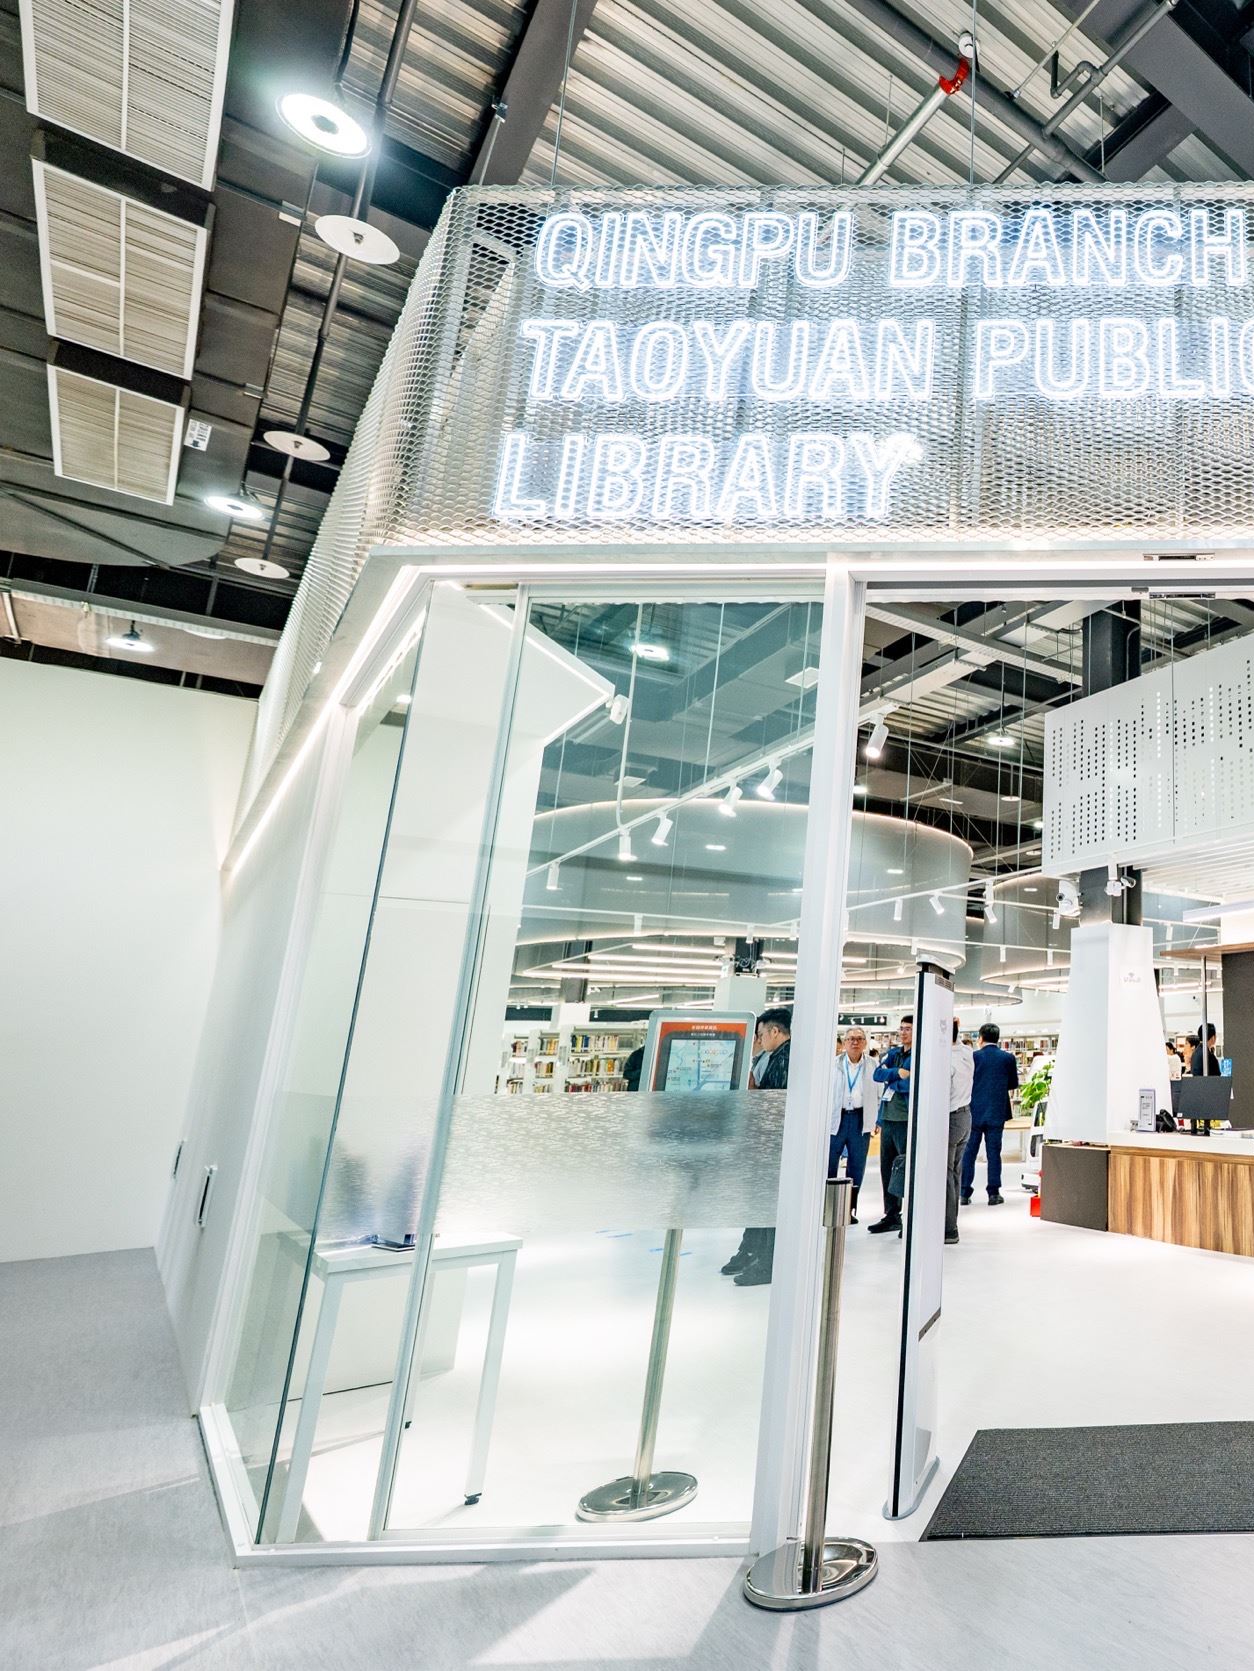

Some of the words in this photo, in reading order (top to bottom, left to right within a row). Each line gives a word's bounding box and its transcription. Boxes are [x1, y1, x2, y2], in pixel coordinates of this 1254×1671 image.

[534, 209, 855, 292] QINGPU
[887, 207, 1249, 288] BRANCH
[520, 316, 938, 402] TAOYUAN
[492, 432, 918, 521] LIBRARY
